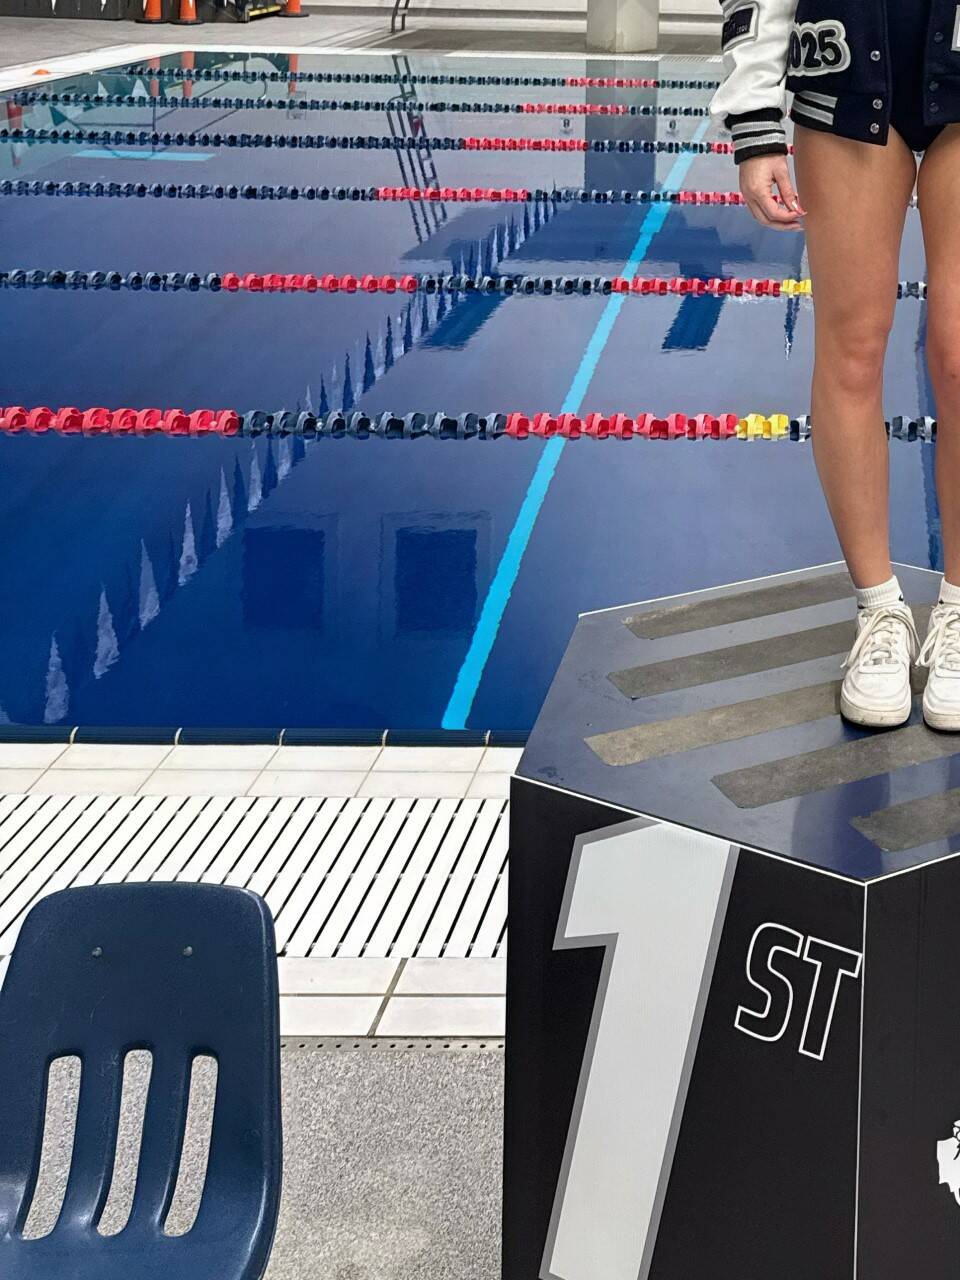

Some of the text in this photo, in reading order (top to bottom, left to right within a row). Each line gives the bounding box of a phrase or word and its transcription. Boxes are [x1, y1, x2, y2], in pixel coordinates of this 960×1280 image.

[788, 28, 842, 68] 025
[539, 817, 863, 1280] 1 ST
